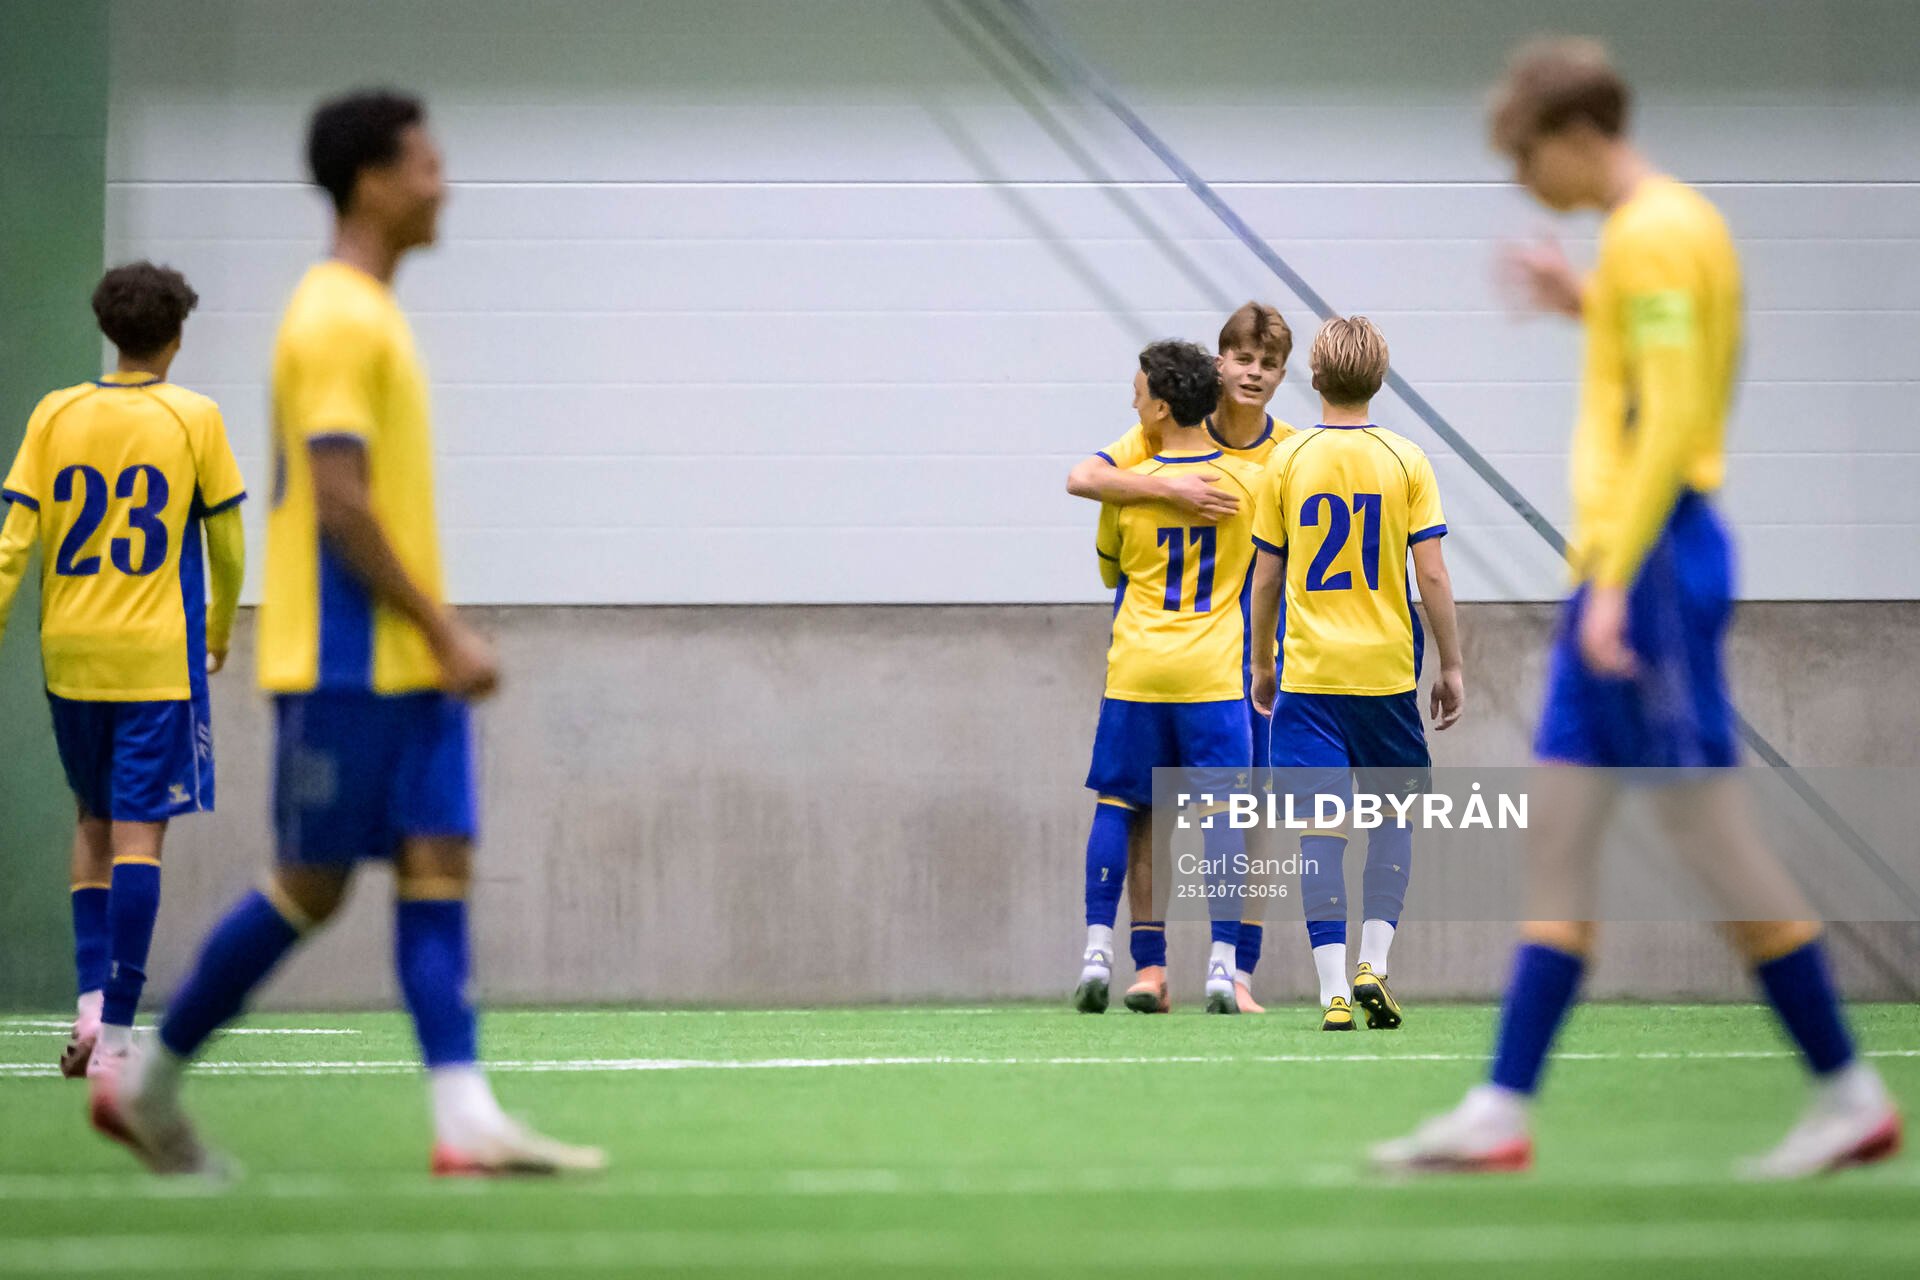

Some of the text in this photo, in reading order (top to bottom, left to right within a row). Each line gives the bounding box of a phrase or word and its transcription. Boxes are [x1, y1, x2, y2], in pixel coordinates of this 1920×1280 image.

[54, 464, 169, 577] 23
[1157, 527, 1217, 612] 11
[1300, 493, 1382, 592] 21
